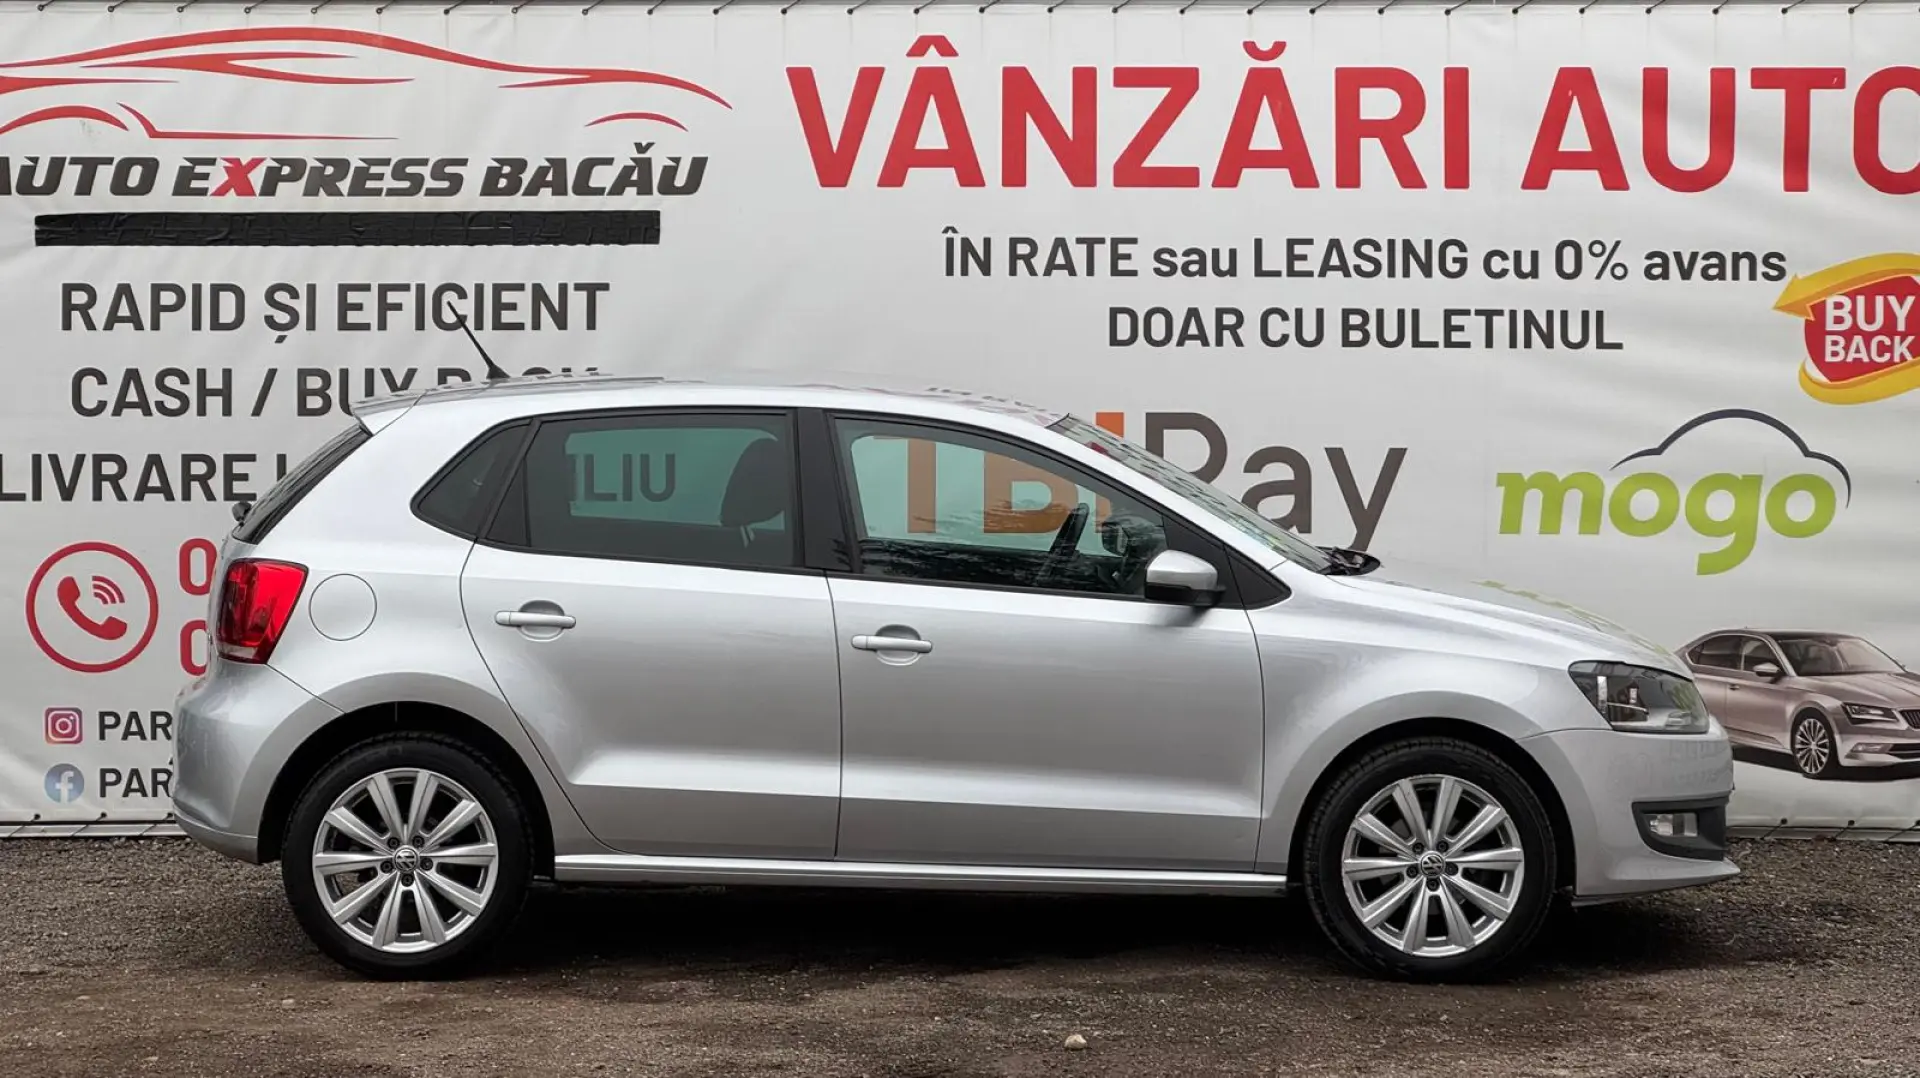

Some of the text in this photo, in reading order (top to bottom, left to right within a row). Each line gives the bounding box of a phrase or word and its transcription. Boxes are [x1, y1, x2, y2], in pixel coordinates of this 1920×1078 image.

[786, 35, 1920, 194] VÂNZĂRI AUTO
[0, 142, 708, 197] UTO EXPRESS BACĂU
[942, 226, 1787, 282] ÎN RATE sau LEASING cu 0% avans
[61, 282, 610, 344] RAPID ȘI EFICIENT
[1109, 306, 1623, 350] DOAR CU BULETINUL
[1825, 294, 1916, 332] BUY
[1825, 334, 1915, 363] BACK
[71, 367, 233, 418] CASH
[251, 367, 278, 417] /
[0, 453, 258, 502] LIVRARE
[1496, 471, 1836, 576] mogo
